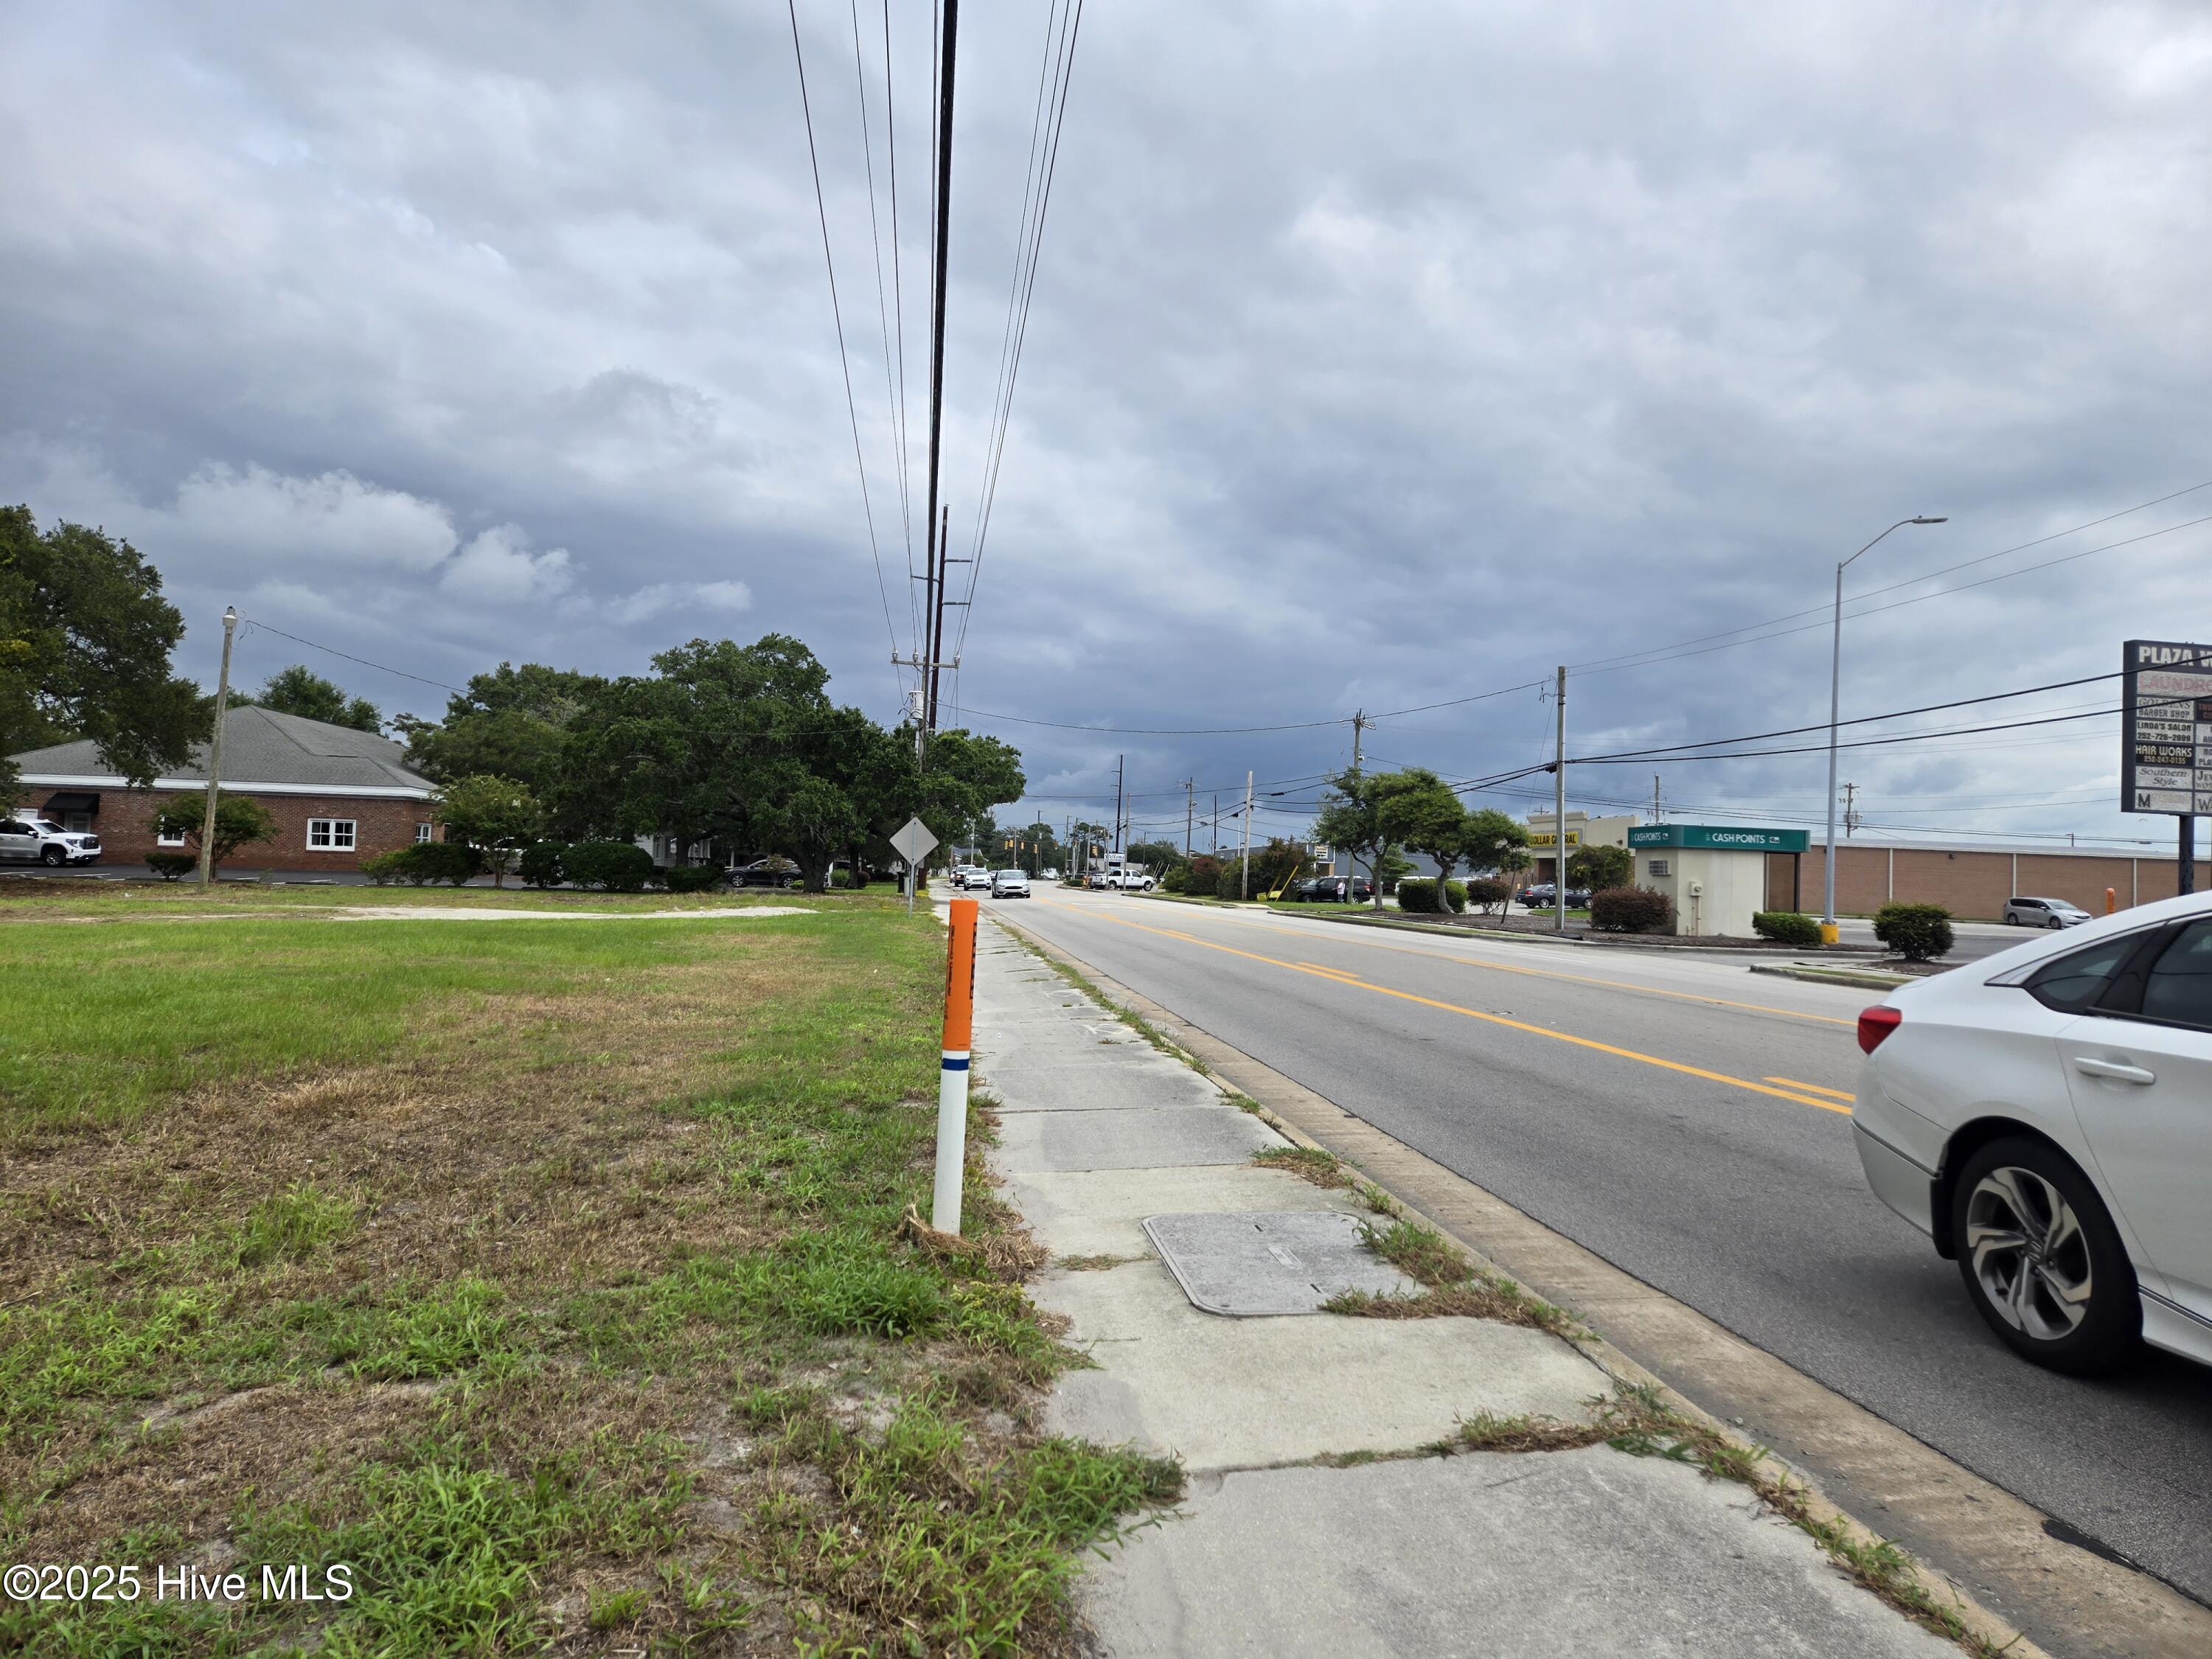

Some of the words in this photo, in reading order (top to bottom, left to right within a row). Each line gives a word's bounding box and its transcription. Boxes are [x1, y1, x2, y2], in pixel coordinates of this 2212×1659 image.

[2139, 646, 2194, 667] PLAZA
[2139, 709, 2168, 717] BARBER
[2170, 710, 2190, 718] SHOP
[2138, 722, 2166, 730] LINDA'S
[2168, 723, 2191, 731] SALON
[2135, 745, 2157, 755] HAIR
[2159, 746, 2192, 757] WORKS
[2140, 768, 2187, 777] Southern
[2153, 777, 2177, 786] Style
[1530, 835, 1550, 844] DOLLAR
